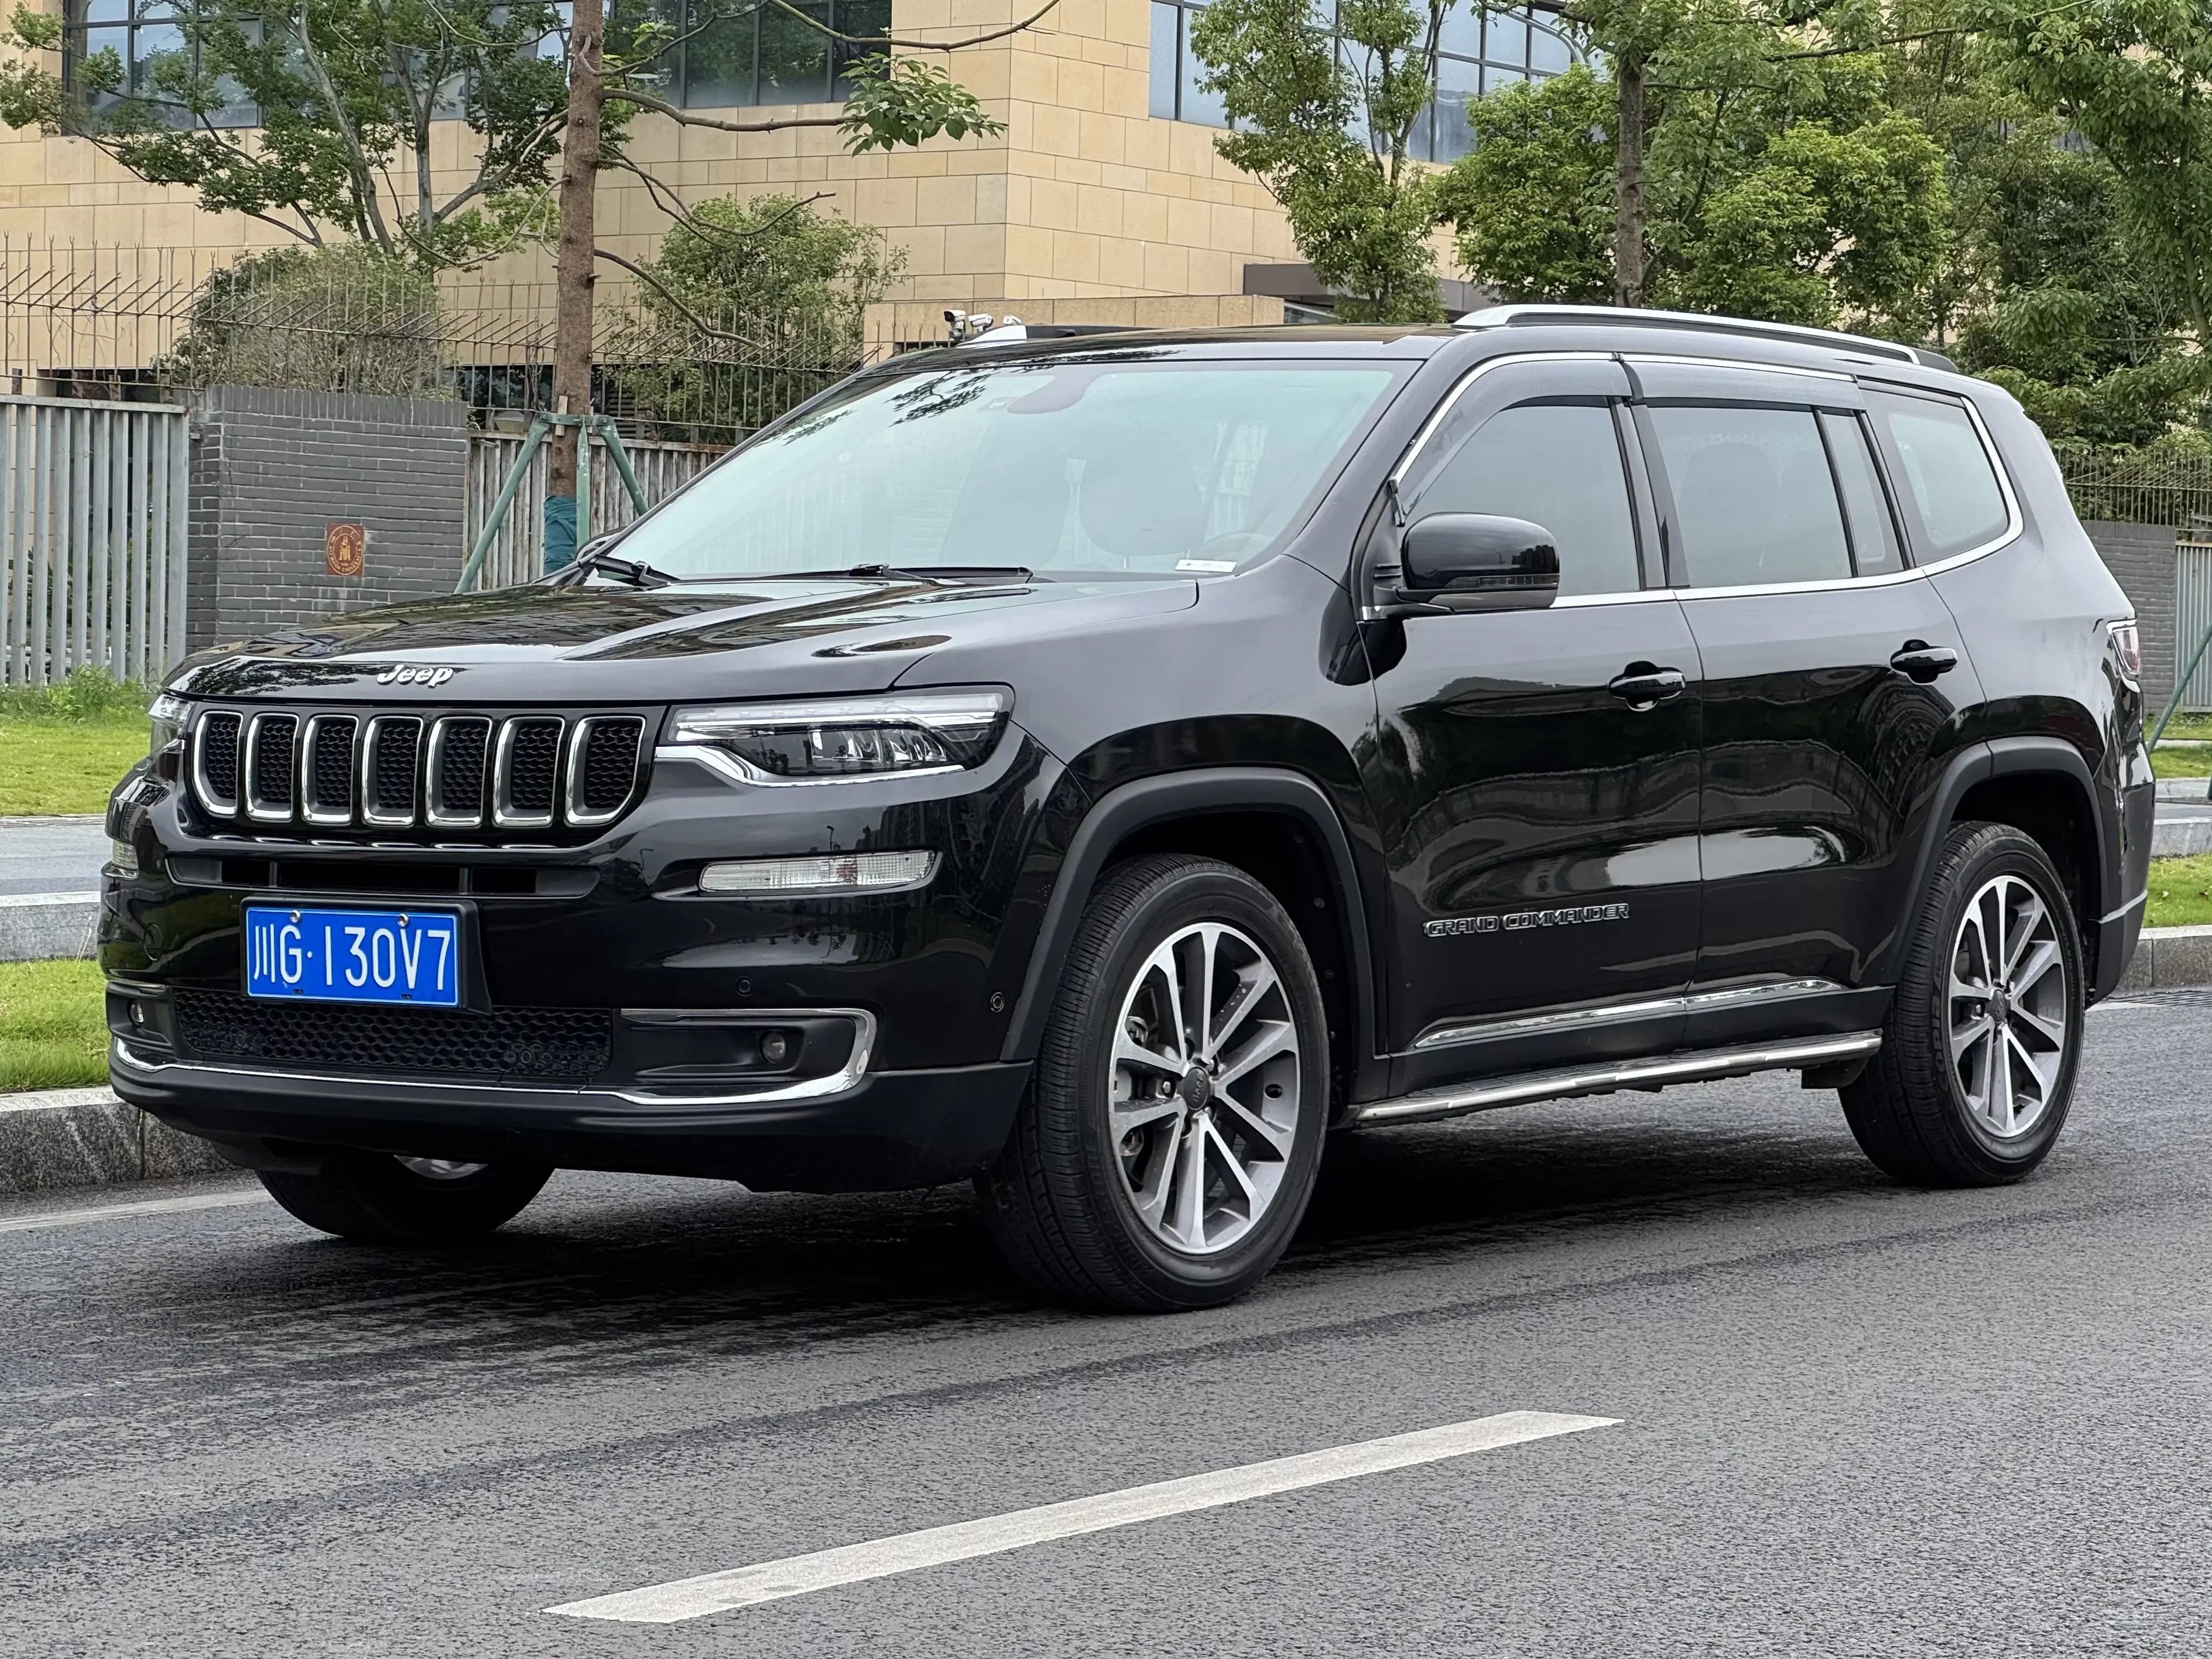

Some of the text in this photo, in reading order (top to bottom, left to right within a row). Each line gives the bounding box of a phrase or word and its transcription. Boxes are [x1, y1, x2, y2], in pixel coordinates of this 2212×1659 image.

[376, 664, 454, 688] Jeep
[1424, 903, 1629, 937] GRAND COMMANDER
